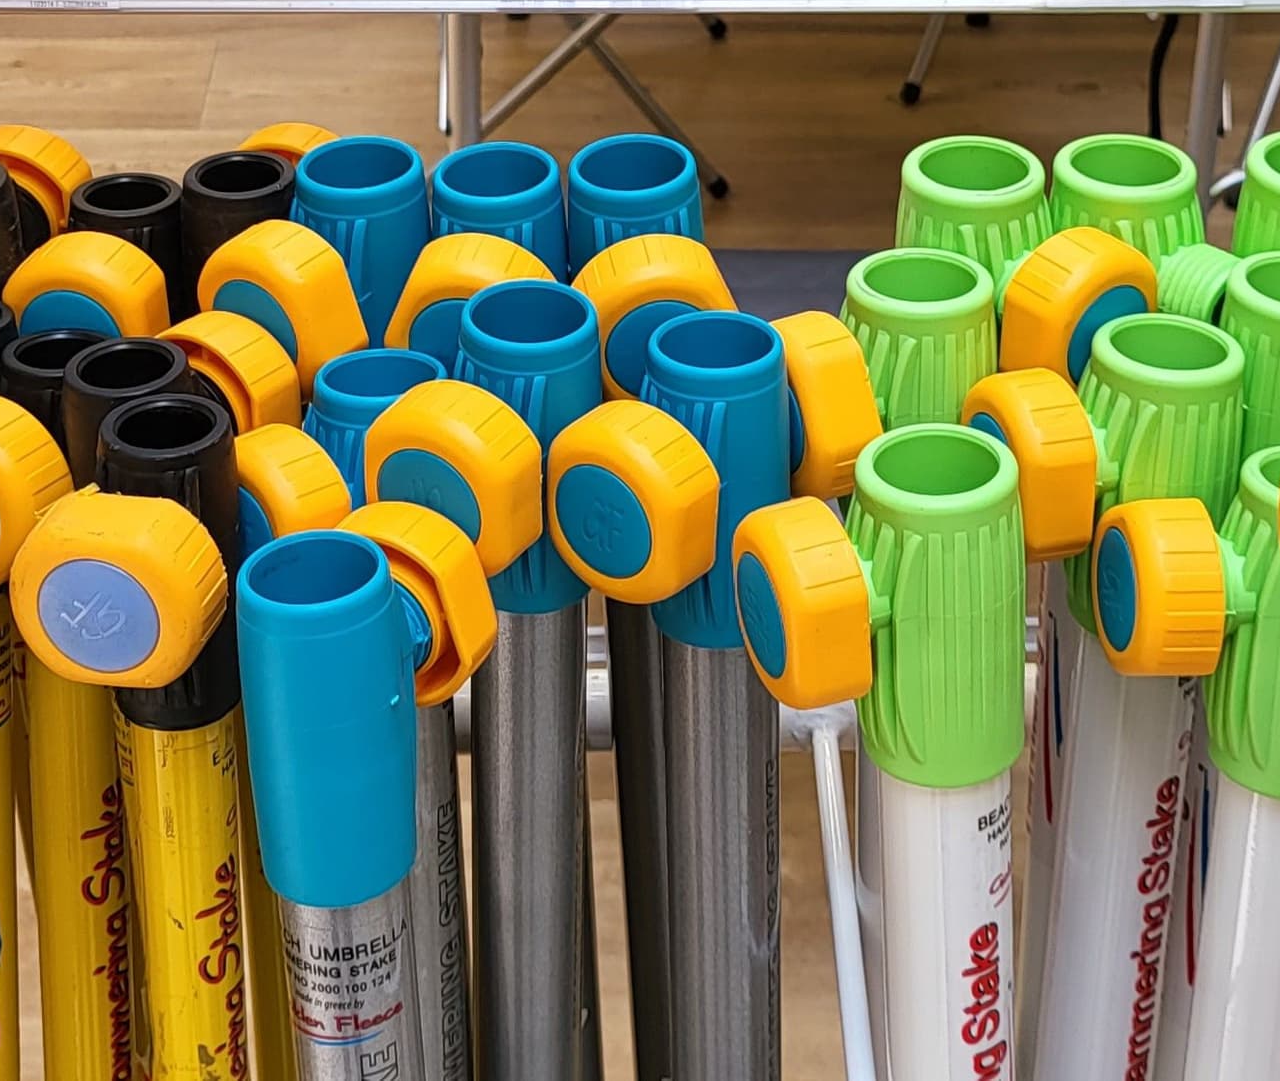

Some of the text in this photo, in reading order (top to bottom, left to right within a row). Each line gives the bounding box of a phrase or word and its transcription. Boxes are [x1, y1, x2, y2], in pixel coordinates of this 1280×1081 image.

[1138, 774, 1180, 896] Stake
[309, 918, 408, 962] UMBRELLA
[349, 948, 397, 978] STAKE
[311, 982, 340, 994] 2000
[345, 982, 367, 994] 100
[371, 972, 391, 988] 124
[961, 921, 999, 1046] Stake
[324, 1000, 352, 1011] greece
[354, 998, 365, 1010] by
[334, 1000, 404, 1032] Fleece
